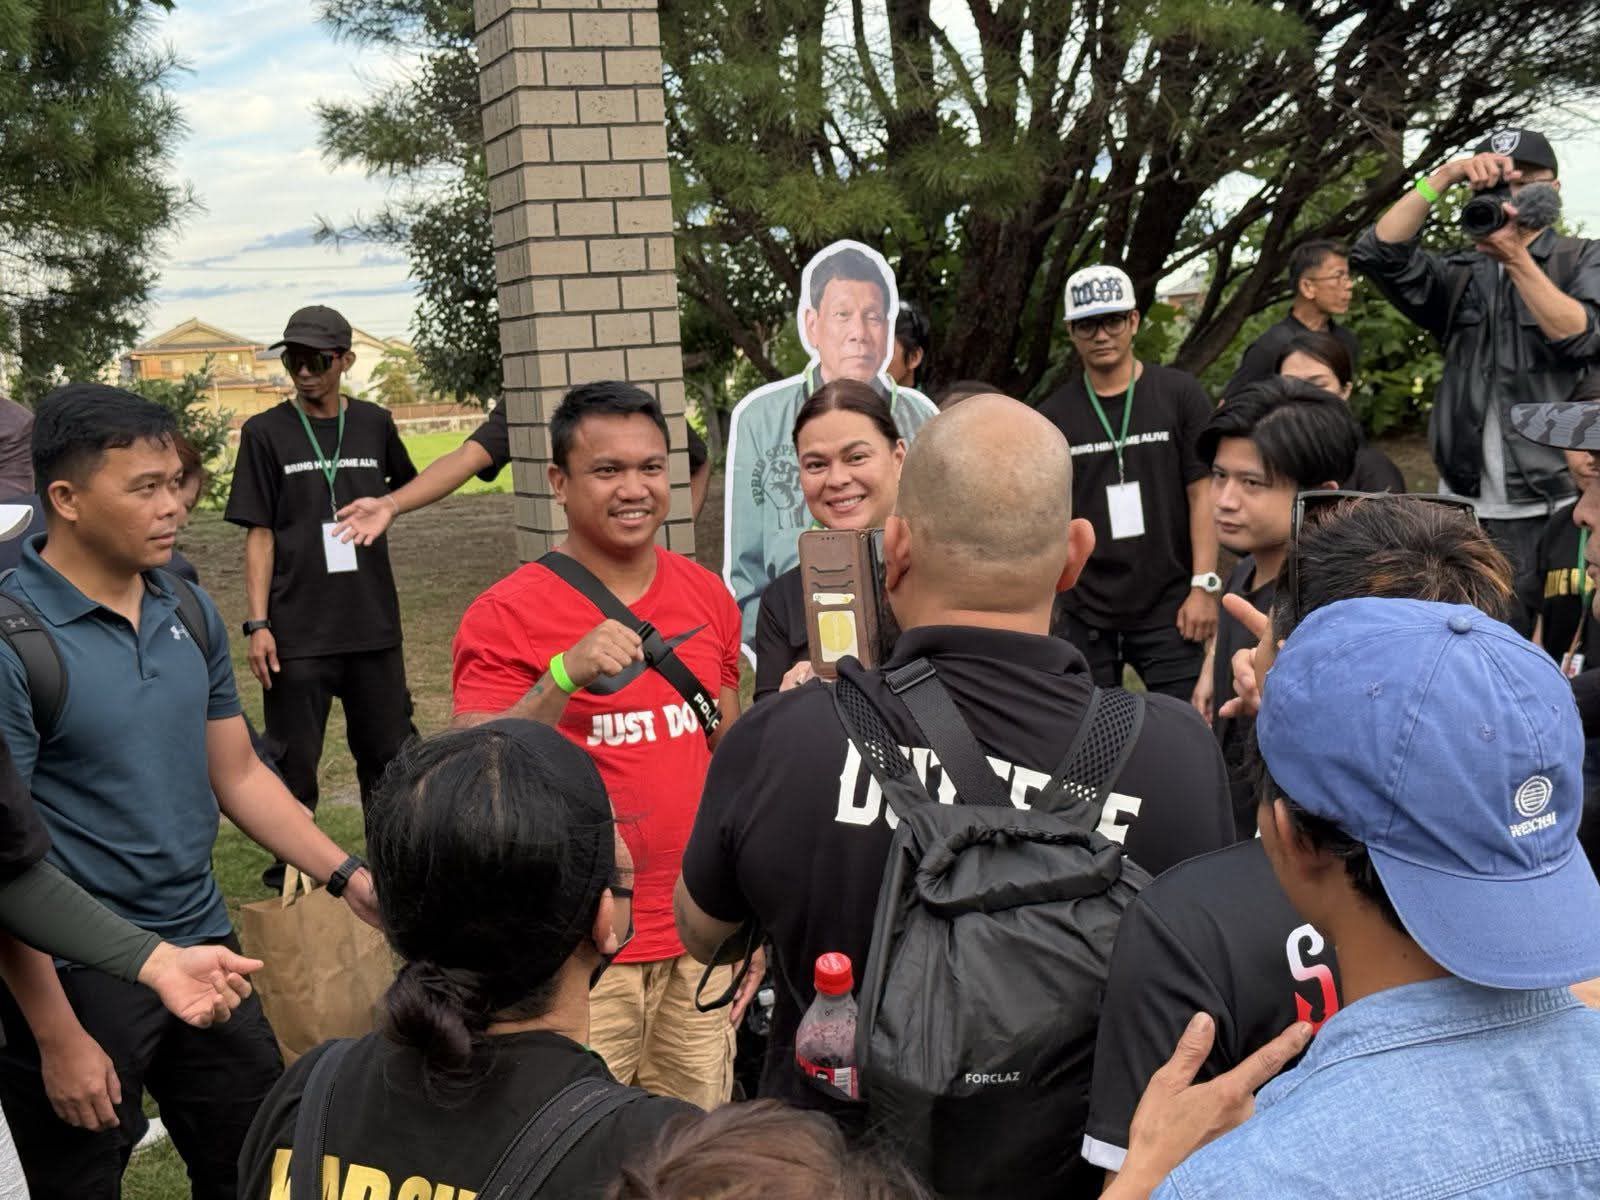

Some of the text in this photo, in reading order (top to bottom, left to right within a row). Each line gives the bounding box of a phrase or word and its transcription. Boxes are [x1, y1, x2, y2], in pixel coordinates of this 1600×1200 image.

[1070, 443, 1094, 456] RING
[1114, 434, 1140, 449] HME
[1141, 431, 1170, 442] ALIVE
[284, 461, 313, 475] BRING
[314, 459, 332, 470] HM
[333, 458, 359, 468] OME
[586, 701, 699, 747] JUST DO
[965, 1071, 1021, 1085] FORCLAZ
